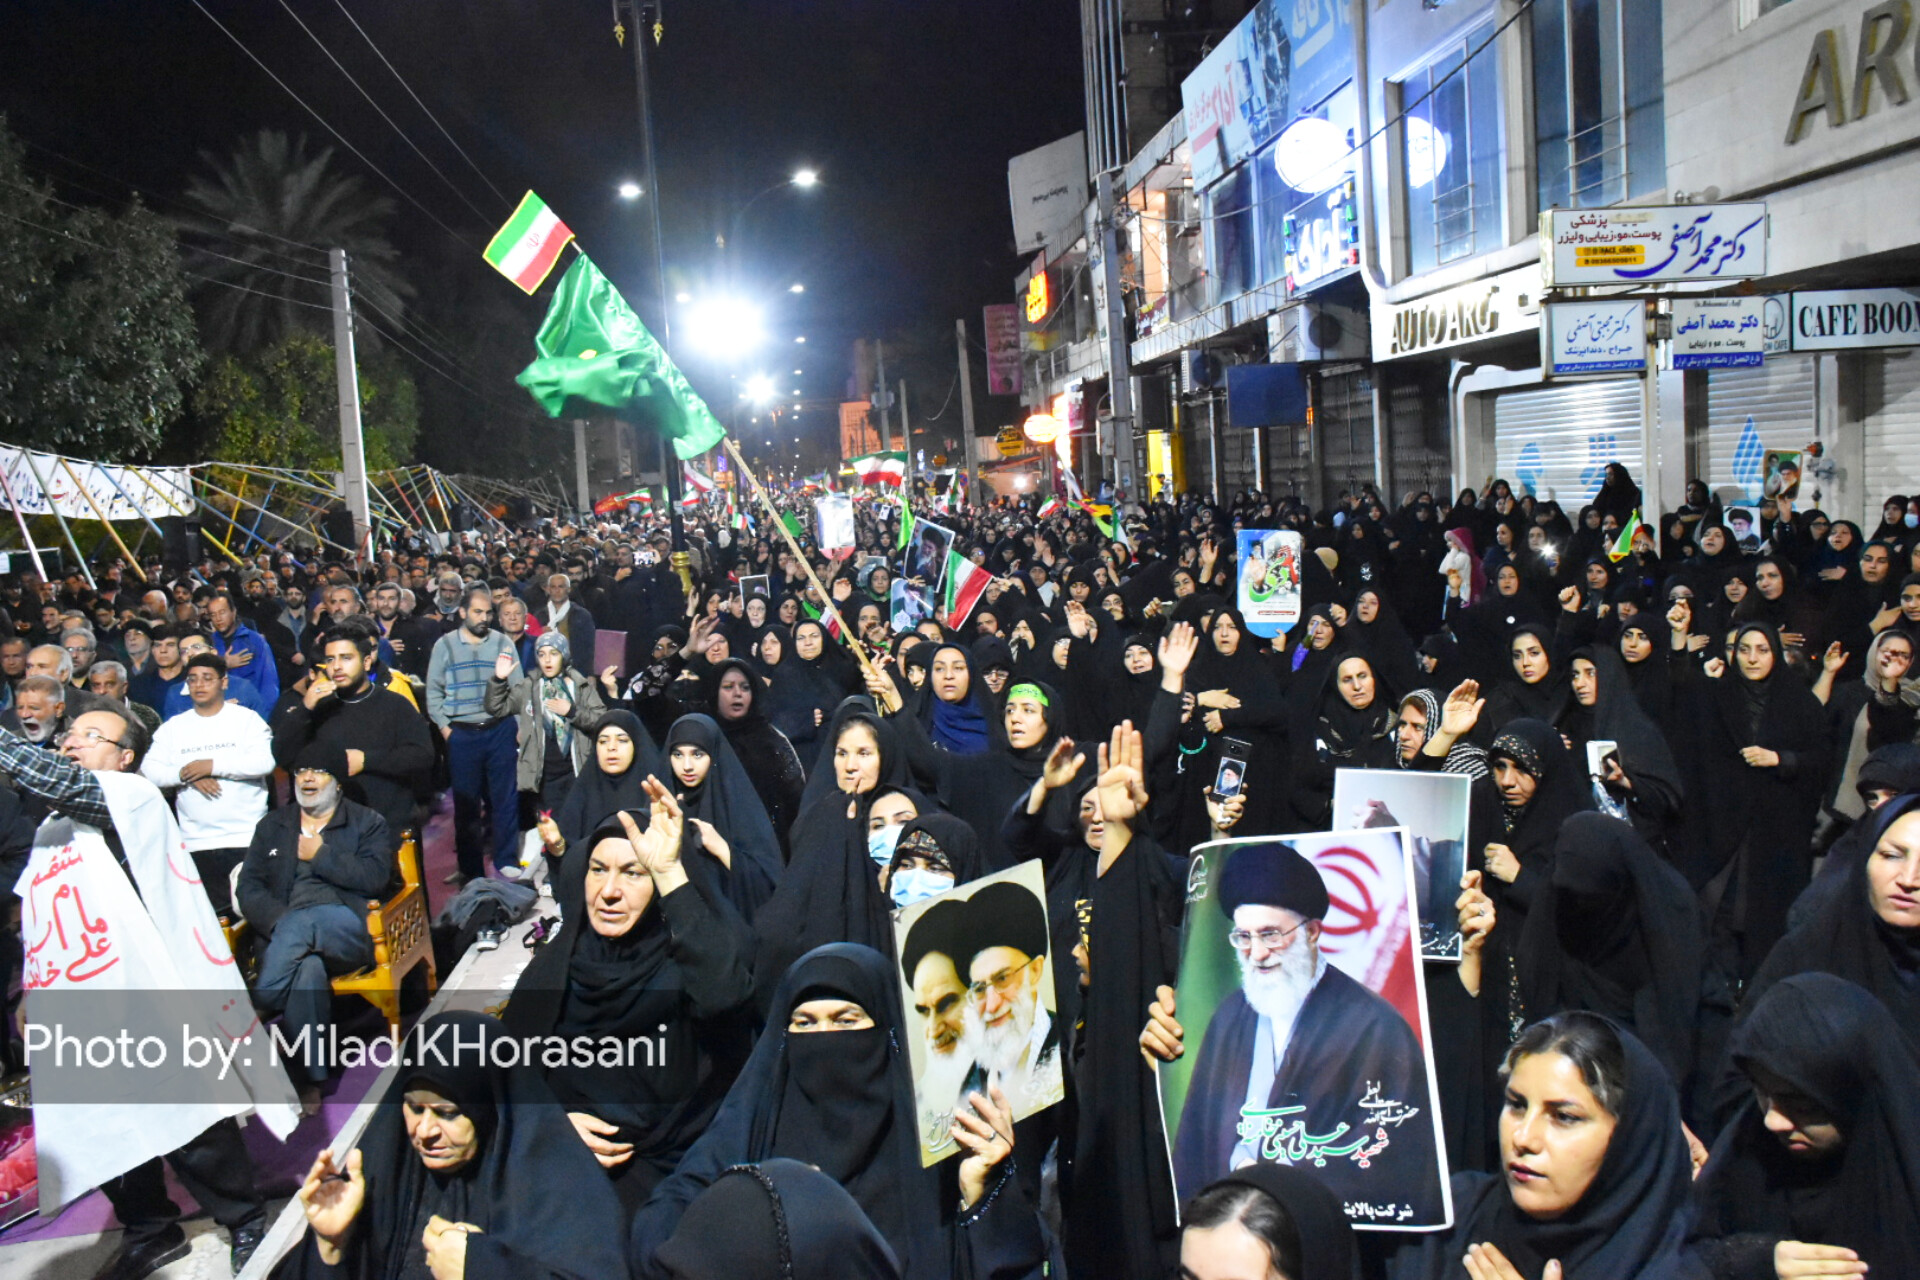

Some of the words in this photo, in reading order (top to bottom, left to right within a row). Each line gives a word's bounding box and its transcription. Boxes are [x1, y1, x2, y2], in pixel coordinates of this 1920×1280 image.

[1570, 213, 1608, 229] پزشکی
[1613, 211, 1713, 278] آصفی
[1683, 235, 1723, 274] محمد
[1711, 216, 1764, 275] دکتر
[1391, 300, 1447, 354] AUTO
[1449, 285, 1499, 341] ARG
[1566, 312, 1597, 343] آصفی
[1606, 303, 1639, 341] دکتر
[1677, 313, 1706, 334] آصفی
[1708, 317, 1736, 330] محمد
[1738, 314, 1759, 333] دکتر
[1798, 303, 1857, 338] CAFE
[1287, 1121, 1351, 1161] علی
[1305, 1134, 1370, 1167] سید
[1350, 1126, 1390, 1168] شهید
[1375, 1203, 1414, 1221] شرکت
